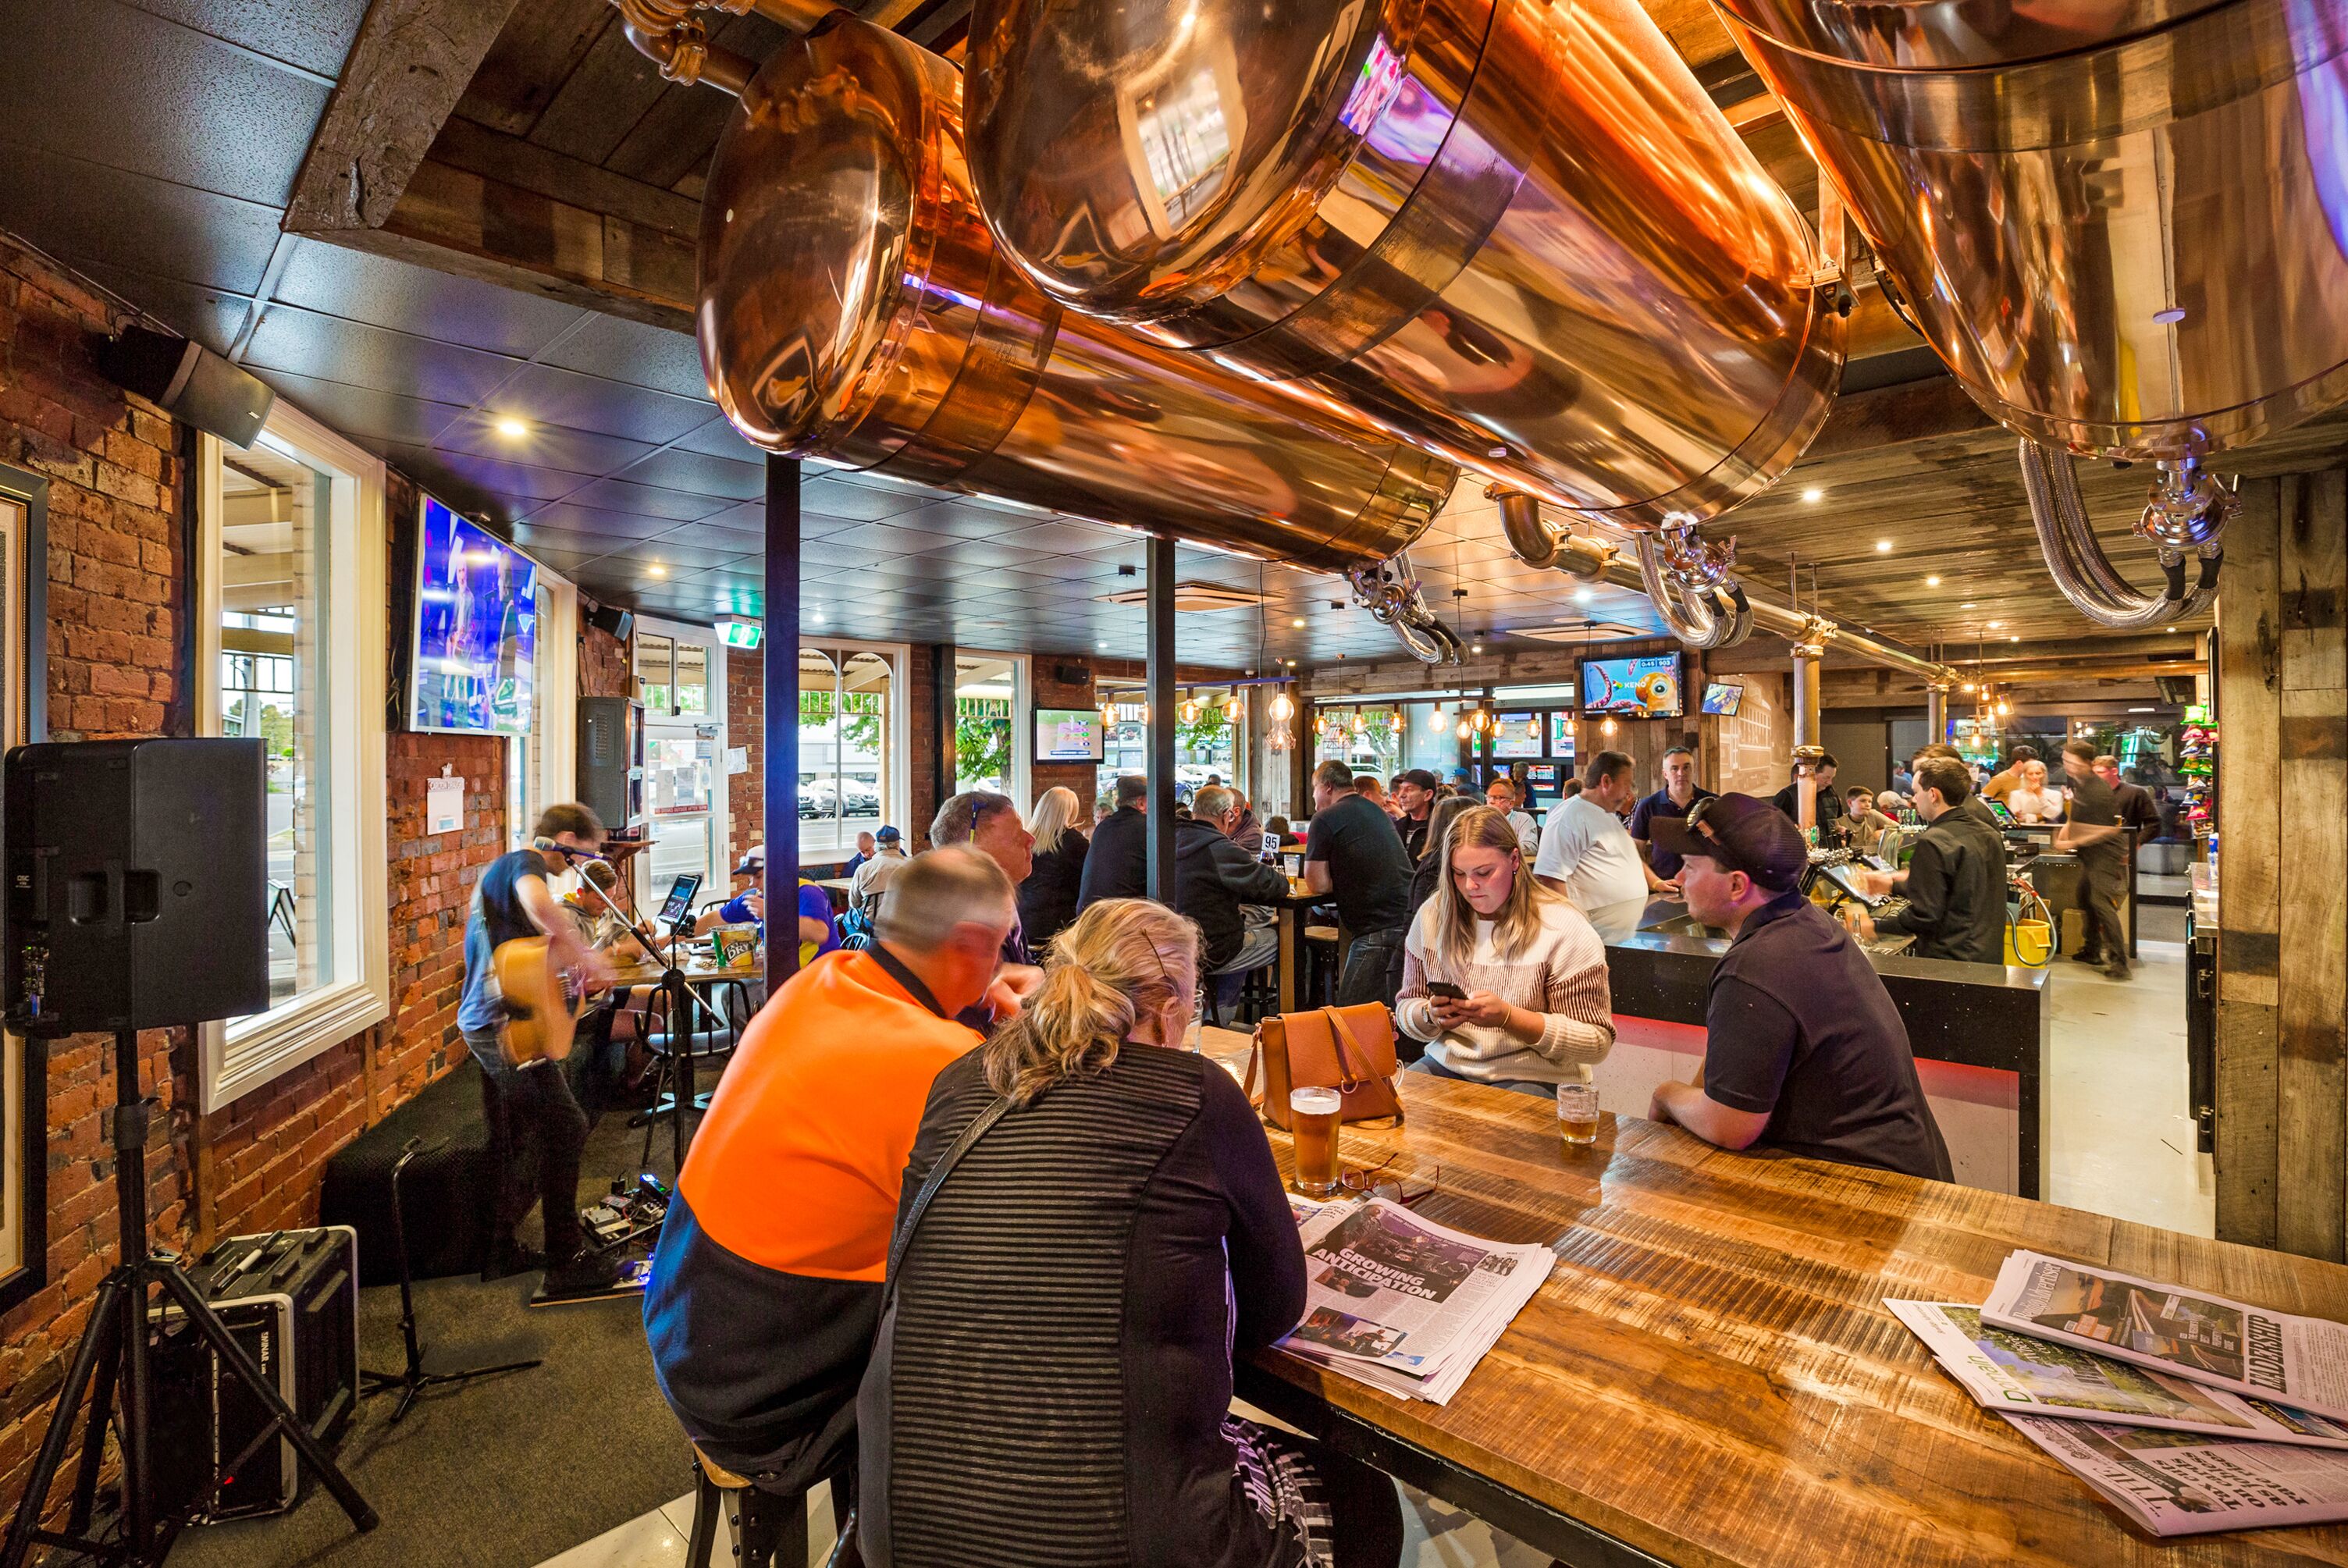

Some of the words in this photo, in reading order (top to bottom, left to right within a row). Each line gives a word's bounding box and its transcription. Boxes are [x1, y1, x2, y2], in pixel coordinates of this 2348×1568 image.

[1265, 835, 1277, 850] 95
[728, 944, 749, 960] DRY
[1311, 1248, 1437, 1300] ANTICIPATION
[1339, 1247, 1425, 1286] GROWING
[2026, 1264, 2062, 1306] Advertiser
[2248, 1314, 2287, 1395] LEADERSHIP
[1966, 1355, 2033, 1403] Domain
[2152, 1459, 2200, 1482] cuts
[2171, 1458, 2234, 1488] cards
[2181, 1451, 2264, 1488] jobless
[2200, 1450, 2257, 1477] rises
[2093, 1467, 2170, 1509] THE
[2199, 1484, 2244, 1510] Tax
[2232, 1488, 2266, 1508] on
[2255, 1477, 2311, 1506] rate
[2257, 1489, 2288, 1506] as
